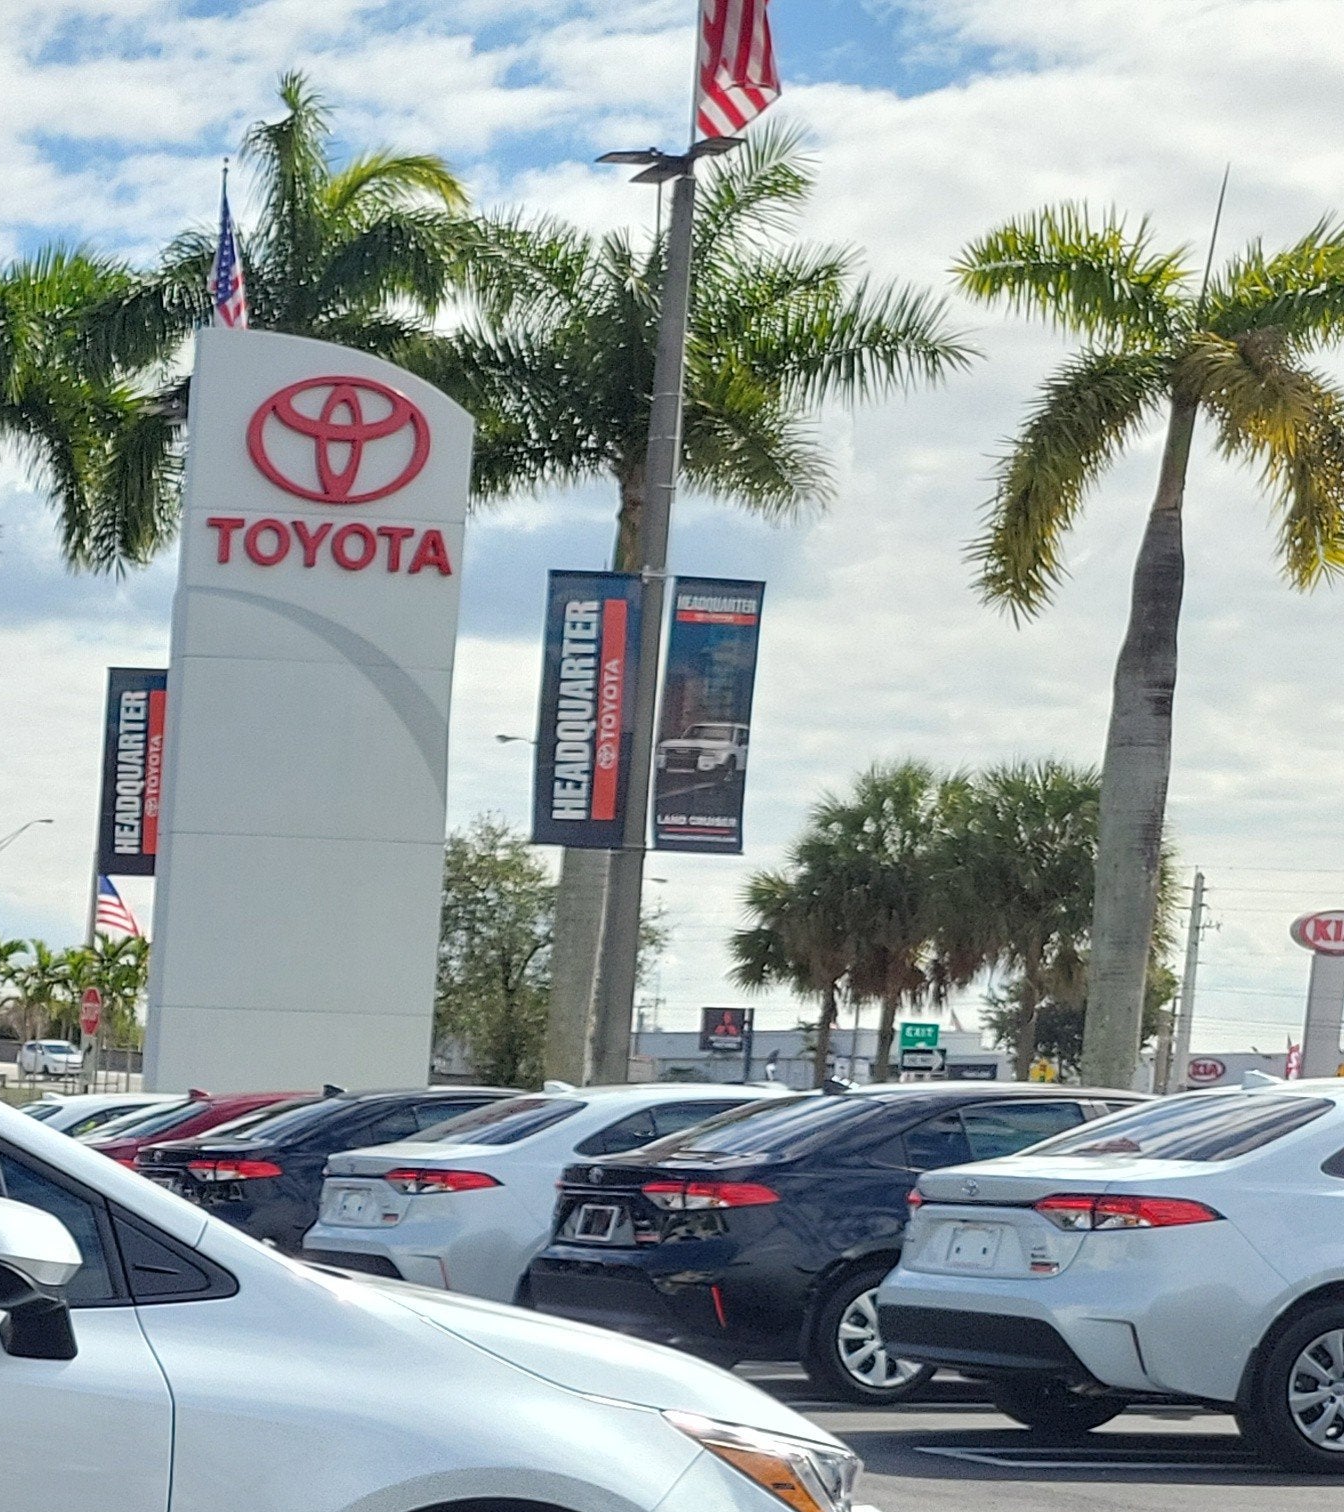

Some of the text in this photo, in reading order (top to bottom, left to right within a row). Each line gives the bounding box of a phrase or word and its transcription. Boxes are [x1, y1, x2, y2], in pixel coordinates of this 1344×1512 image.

[206, 517, 453, 577] TOYOTA
[551, 599, 601, 821] HEADQUARTER
[600, 658, 622, 741] TOYOTA
[114, 690, 148, 855] HEADQUARTER
[146, 734, 164, 797] TOYOTA
[1312, 918, 1344, 942] KI
[905, 1025, 935, 1038] EXIT
[1190, 1061, 1219, 1076] KIA
